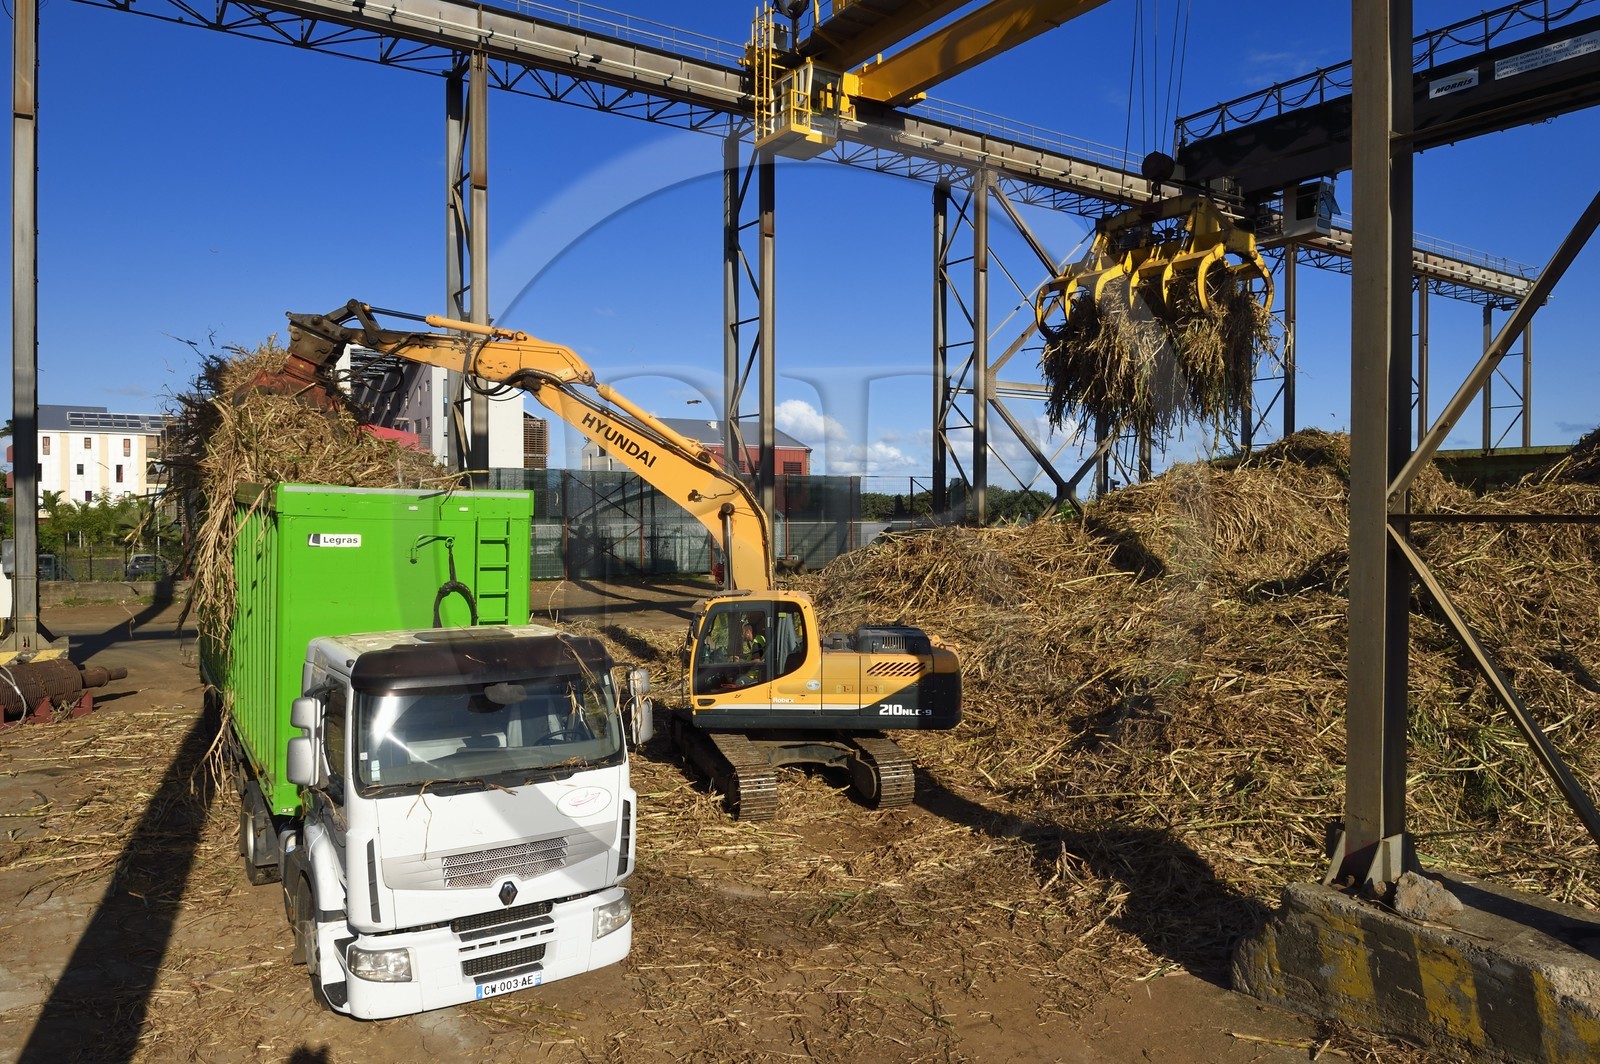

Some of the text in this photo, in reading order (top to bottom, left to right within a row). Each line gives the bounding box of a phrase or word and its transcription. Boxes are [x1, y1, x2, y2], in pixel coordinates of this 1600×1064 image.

[1435, 78, 1473, 94] MORRIS
[582, 412, 657, 468] HYUNDAI
[323, 536, 358, 545] Legras
